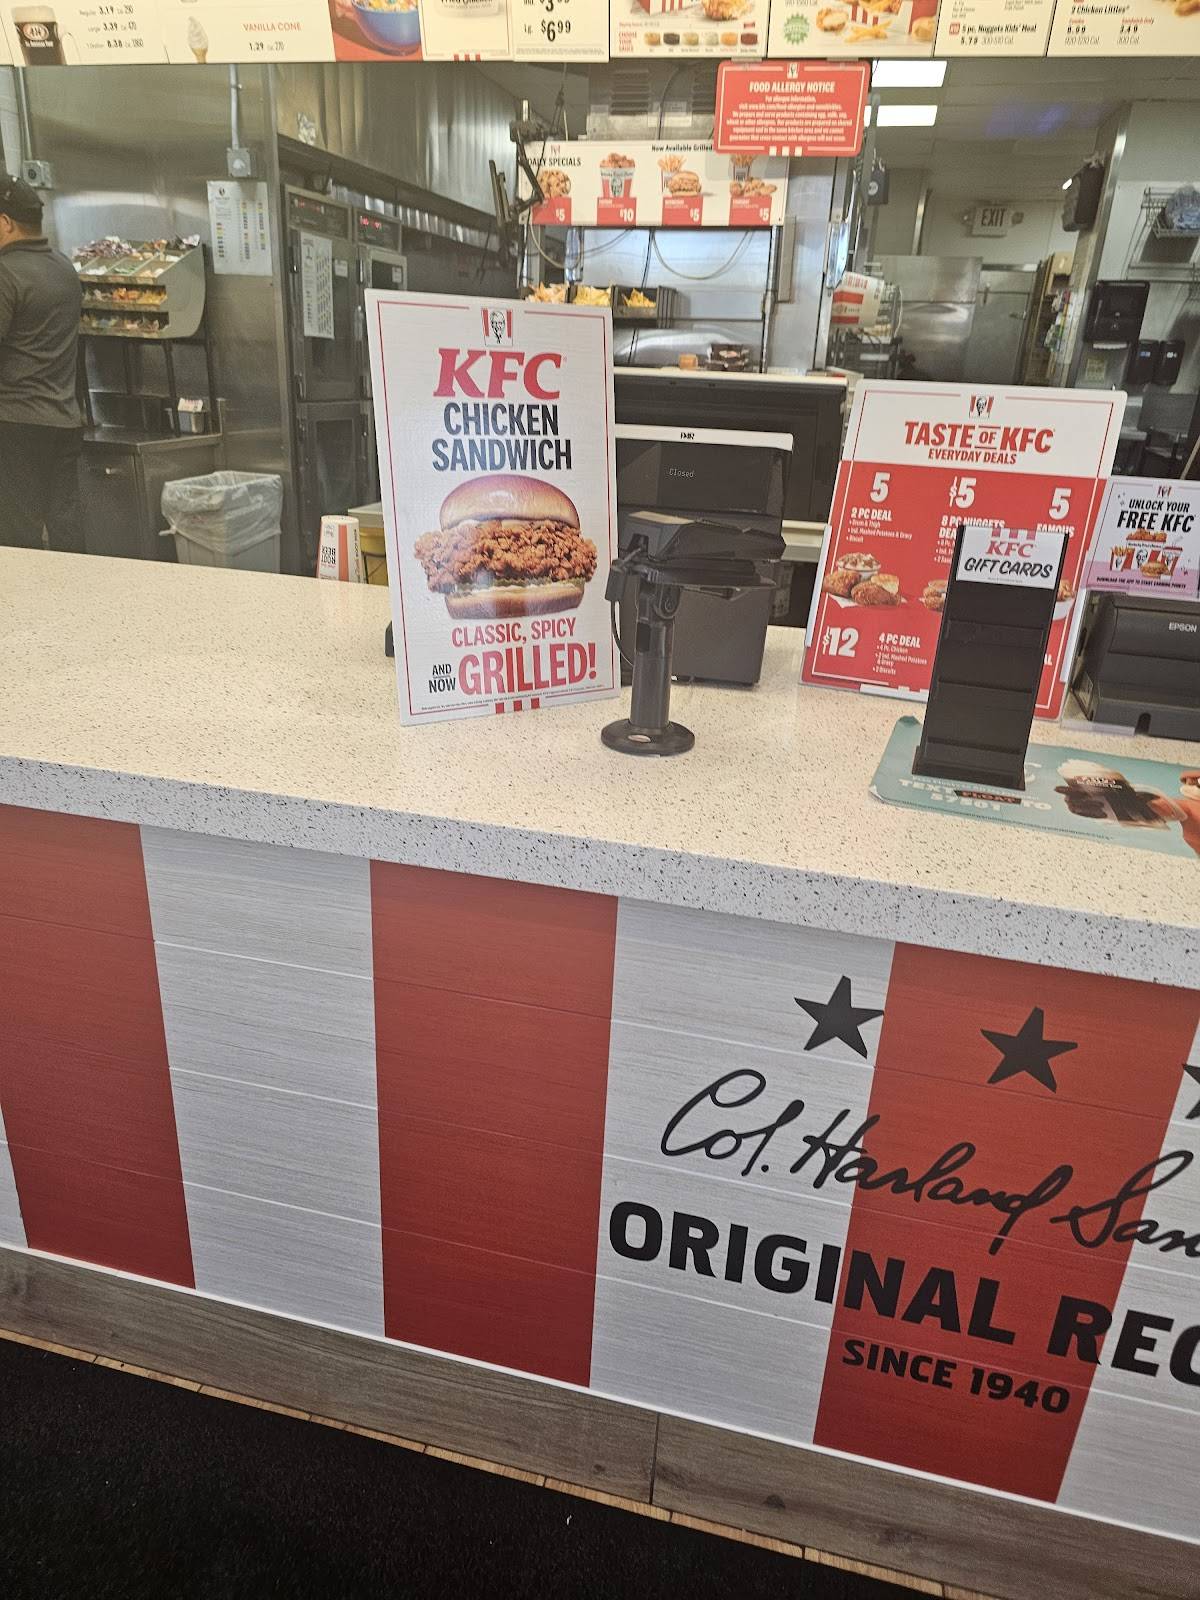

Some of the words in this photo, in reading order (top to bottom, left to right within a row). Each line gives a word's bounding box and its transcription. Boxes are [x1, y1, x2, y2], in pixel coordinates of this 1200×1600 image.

[1076, 5, 1103, 13] Chicken
[243, 23, 276, 32] VANILLA
[278, 22, 302, 31] CONE
[749, 81, 770, 93] FOOD
[771, 81, 806, 93] ALLERGY
[806, 81, 836, 93] NOTICE
[651, 144, 665, 152] Now
[666, 144, 692, 152] Available
[693, 143, 713, 152] Grilled
[548, 157, 581, 166] SPECIALS
[620, 207, 634, 222] $10
[981, 208, 1007, 227] EXIT
[433, 348, 562, 400] KFC
[443, 402, 559, 437] CHICKEN
[904, 421, 976, 449] TASTE
[978, 431, 997, 445] OF
[1000, 426, 1054, 454] KFC
[431, 438, 572, 472] SANDWICH
[928, 448, 983, 463] EVERYDAY
[983, 452, 1018, 466] DEALS
[669, 468, 695, 478] Closed
[869, 471, 891, 503] 5
[949, 475, 977, 509] $5
[1048, 487, 1072, 521] 5
[851, 507, 858, 519] 2
[858, 508, 870, 520] PC
[870, 509, 893, 522] DEAL
[1129, 499, 1164, 511] UNLOCK
[1166, 502, 1190, 513] YOUR
[941, 515, 948, 527] 8
[1117, 510, 1159, 530] FREE
[1161, 513, 1195, 533] KFC
[986, 540, 1034, 558] KFC
[964, 557, 1000, 573] GIFT
[999, 559, 1053, 579] CARDS
[451, 622, 528, 649] CLASSIC,
[531, 617, 577, 641] SPICY
[1169, 621, 1198, 634] EPSON
[822, 626, 859, 657] $12
[879, 632, 886, 643] 4
[886, 633, 898, 645] PC
[899, 635, 920, 649] DEAL
[432, 664, 453, 677] AND
[458, 641, 597, 696] GRILLED!
[428, 677, 457, 694] NOW
[660, 1068, 805, 1177] Col.
[789, 1108, 1074, 1256] Harland
[608, 1200, 1015, 1345] ORIGINAL
[841, 1338, 956, 1389] SINCE
[969, 1365, 1071, 1414] 1940
